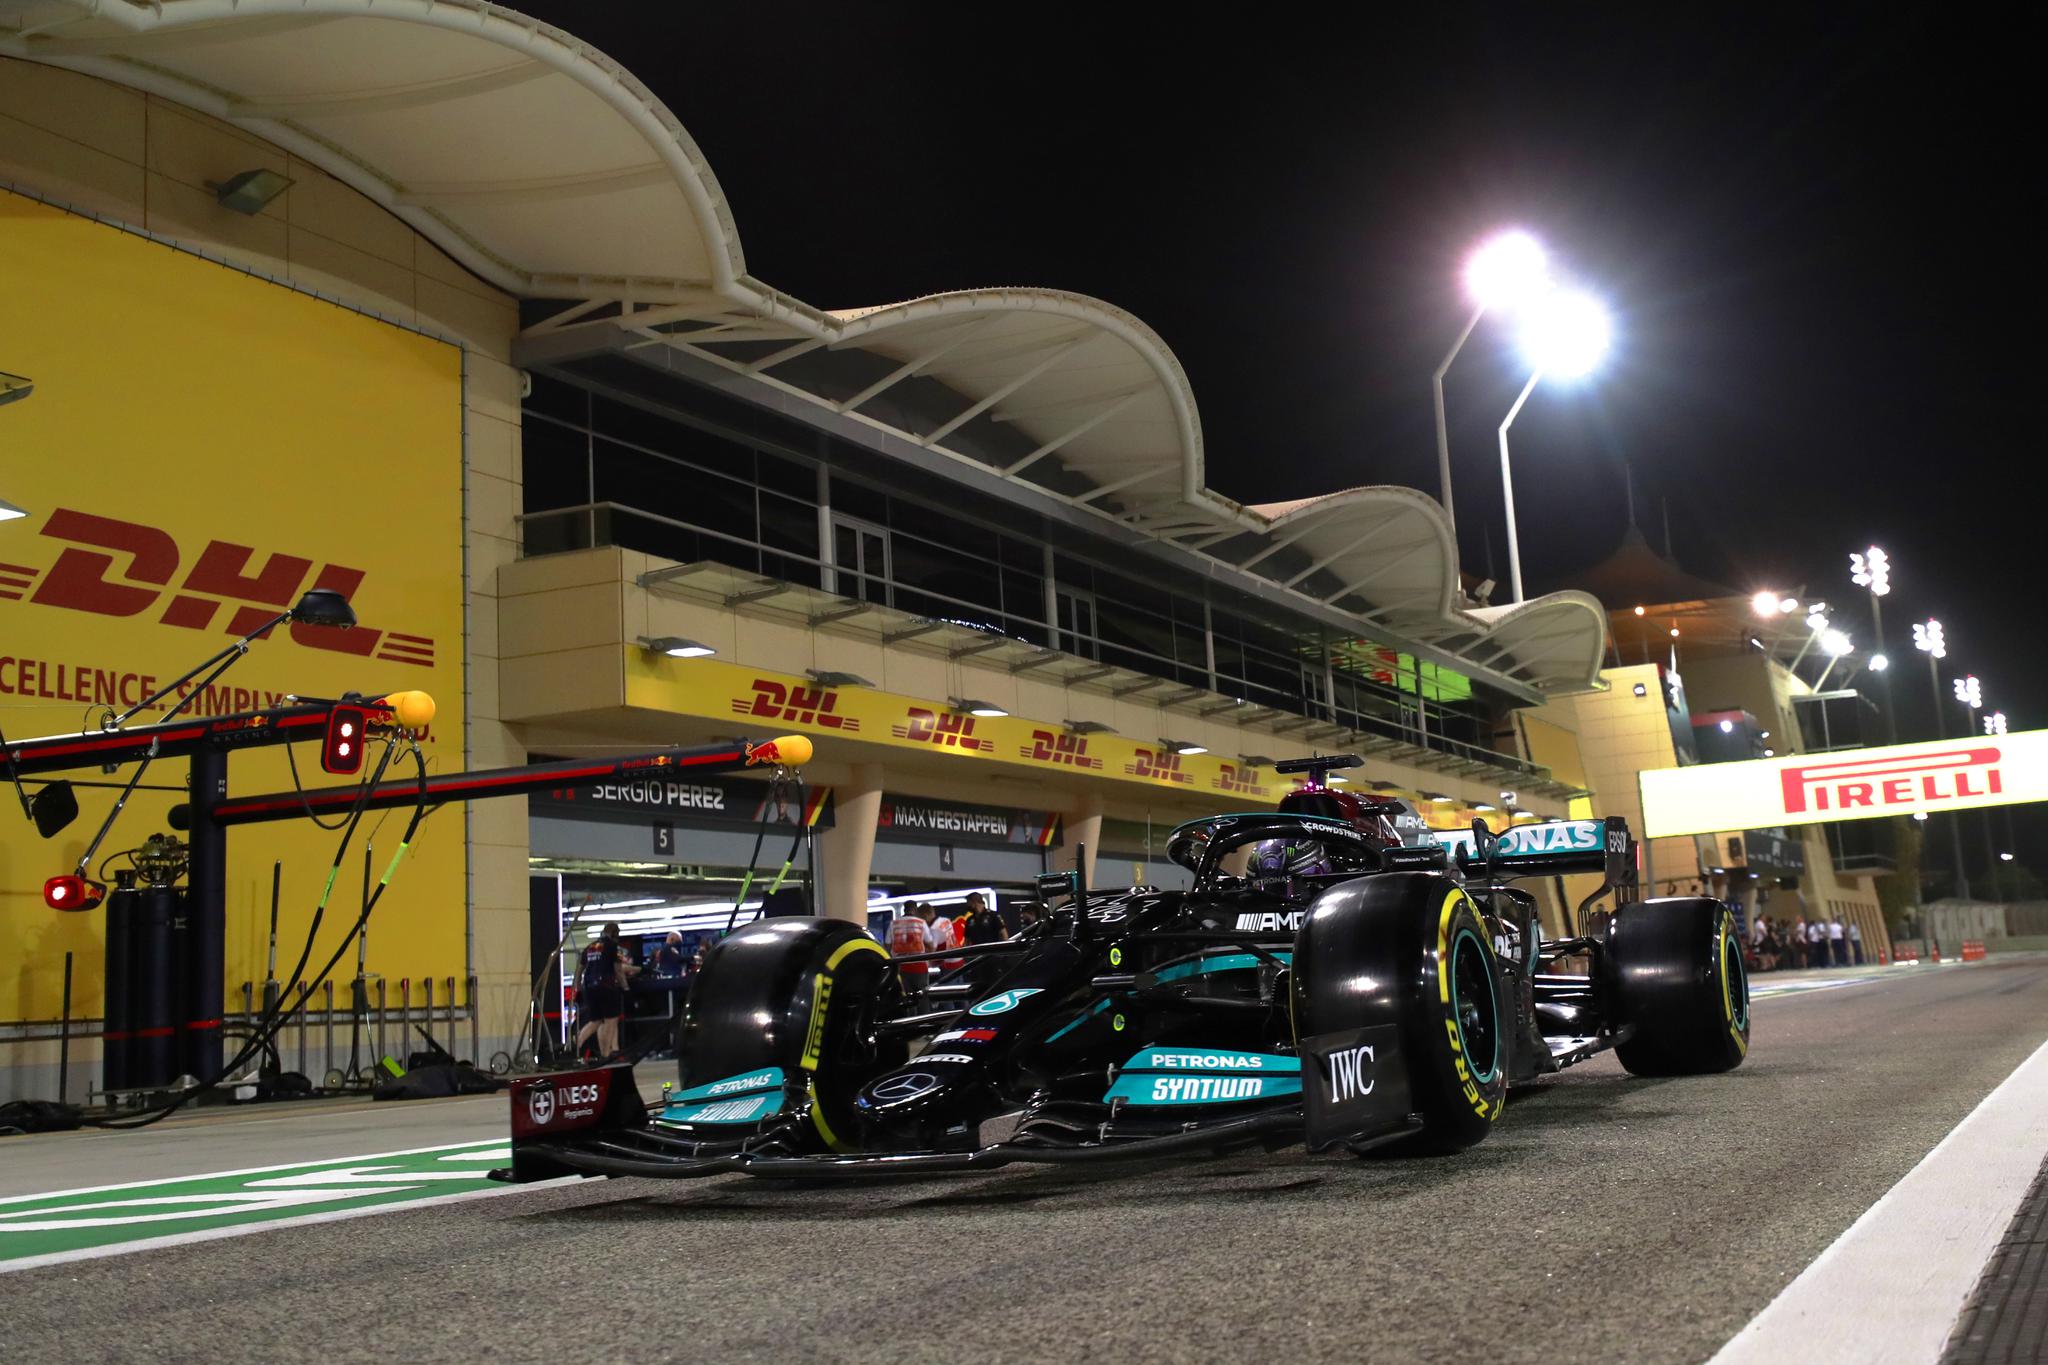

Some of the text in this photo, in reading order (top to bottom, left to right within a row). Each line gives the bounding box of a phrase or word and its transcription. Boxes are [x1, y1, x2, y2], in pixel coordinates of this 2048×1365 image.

[30, 507, 383, 657] DHL
[176, 680, 284, 717] SIMPLY
[750, 678, 845, 730] DHL
[906, 706, 981, 751] DHL
[1031, 729, 1093, 769] DHL
[1135, 748, 1185, 783] DHL
[1220, 764, 1262, 796] DHL
[1780, 747, 2002, 814] PIRELLI
[592, 780, 663, 805] SERGIO
[667, 783, 725, 810] PEREZ
[894, 805, 927, 829] MAX
[928, 809, 1007, 836] VERSTAPPEN
[659, 828, 668, 848] 5
[943, 850, 951, 865] 4
[1151, 1053, 1263, 1069] PETRONAS
[1328, 1045, 1375, 1103] IWC
[558, 1084, 598, 1107] INEOS
[707, 1073, 772, 1095] PETRONAS
[1152, 1077, 1262, 1101] SYNTIUM
[563, 1107, 594, 1120] Hygienics
